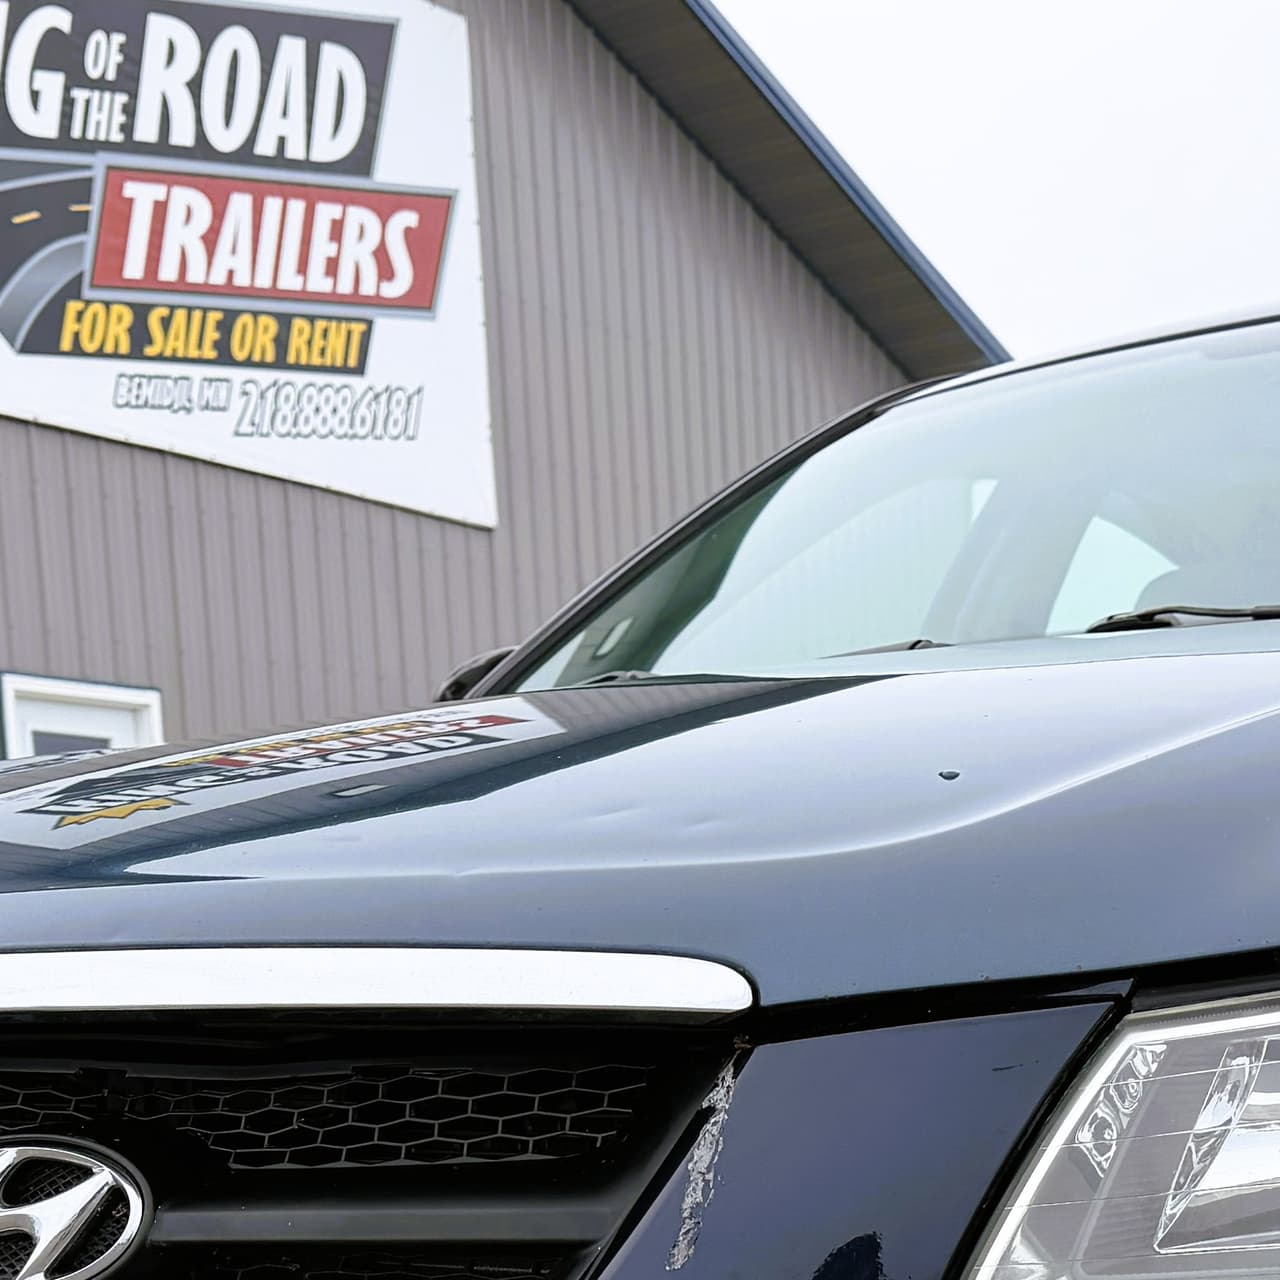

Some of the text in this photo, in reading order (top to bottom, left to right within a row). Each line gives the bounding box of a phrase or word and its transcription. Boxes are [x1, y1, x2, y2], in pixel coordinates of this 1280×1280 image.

[133, 12, 368, 164] ROAD
[121, 181, 419, 298] TRAILERS
[58, 300, 368, 368] FOR SALE OR RENT
